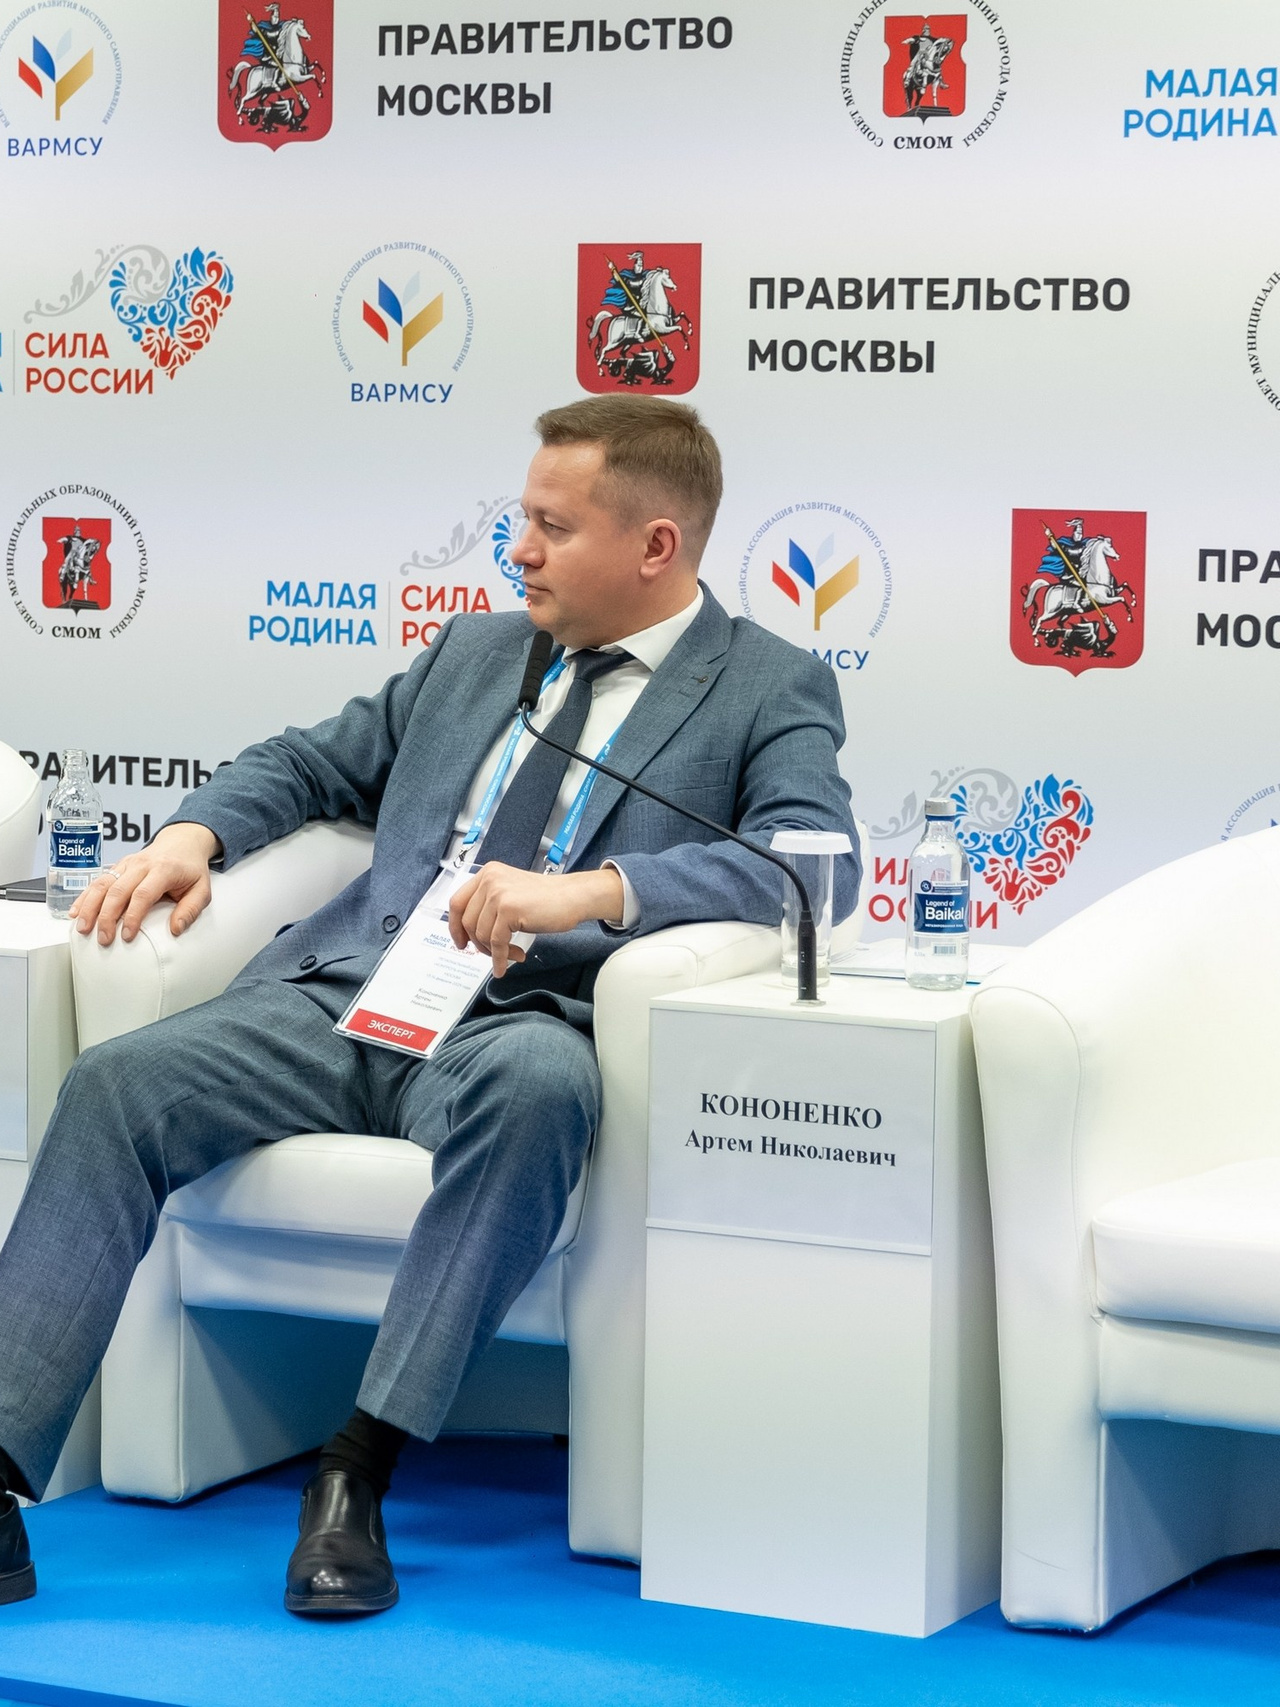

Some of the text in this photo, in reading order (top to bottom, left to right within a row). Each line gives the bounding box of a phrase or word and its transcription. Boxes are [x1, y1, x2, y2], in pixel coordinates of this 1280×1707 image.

[379, 17, 732, 56] ПРАВИТЕЛЬСТВО
[79, 6, 113, 40] МЕСТНОГО
[102, 41, 122, 125] САМОУПРАВЛЕНИЯ
[840, 0, 887, 147] СОВЕТ МУНИЦИПАЛЬН
[378, 82, 551, 116] МОСКВЫ
[962, 26, 1011, 148] ГОРОДА МОСКВЫ
[1146, 68, 1277, 98] МАЛАЯ
[1124, 108, 1276, 141] РОДИНА
[8, 137, 102, 156] ВАРМСУ
[894, 136, 952, 149] СМОМ
[331, 241, 474, 373] ВСЕРОССИЙСКАЯ АССОЦИАЦИЯ РАЗВИТИЯ МЕСТНОГО САМОУПРАВЛЕНИЯ
[750, 278, 1130, 311] ПРАВИТЕЛЬСТВО
[25, 333, 109, 358] СИЛА
[749, 339, 934, 373] МОСКВЫ
[1247, 272, 1280, 411] ОВЕТ МУНИЦИПАЛЬ
[27, 368, 153, 394] РОССИИ
[352, 383, 452, 403] ВАРМСУ
[6, 484, 149, 638] СОВЕТ МУНИЦИПАЛЬНЫХ ОБРАЗОВАНИЙ ГОРОДА МОСКВЫ
[748, 506, 793, 554] АССОЦИАЦИЯ
[795, 502, 842, 514] РАЗВИТИЯ
[843, 509, 882, 547] МЕСТНОГО
[868, 549, 893, 638] САМОУПРАВЛЕНИЯ
[267, 581, 491, 613] МАЛАЯ СИЛА
[52, 626, 100, 638] СМОМ
[250, 616, 376, 646] РОДИНА
[1225, 785, 1276, 833] АССОЦИАЦИЯ
[58, 844, 94, 856] Baikal
[925, 900, 948, 908] Legend
[925, 907, 964, 920] Baikal
[367, 1019, 416, 1040] ЭКСПЕРТ
[700, 1093, 882, 1130] КОНОНЕНКО
[685, 1129, 897, 1167] Артем Николаевич
